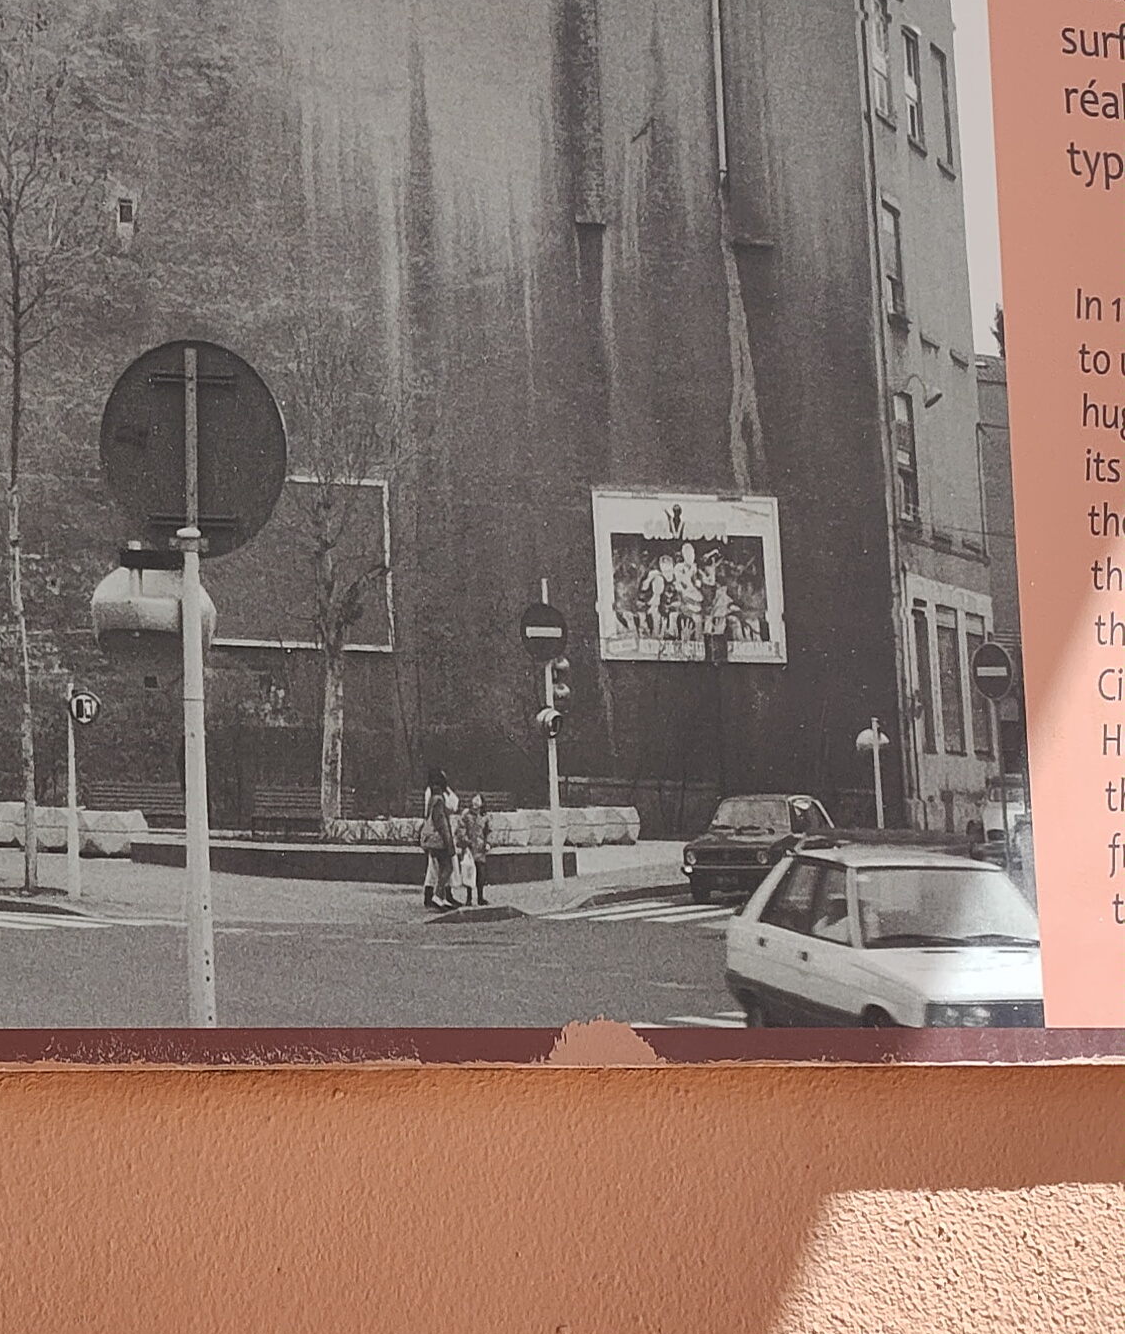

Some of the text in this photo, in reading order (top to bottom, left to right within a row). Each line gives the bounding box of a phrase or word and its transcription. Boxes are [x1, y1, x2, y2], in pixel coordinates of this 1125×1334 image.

[1066, 142, 1124, 190] typ
[1076, 288, 1102, 321] In
[1078, 343, 1111, 375] to
[1082, 393, 1125, 440] hu
[1085, 449, 1121, 483] its
[1088, 502, 1125, 537] th
[1091, 557, 1122, 591] th
[1098, 668, 1123, 702] Ci
[1102, 724, 1121, 757] H
